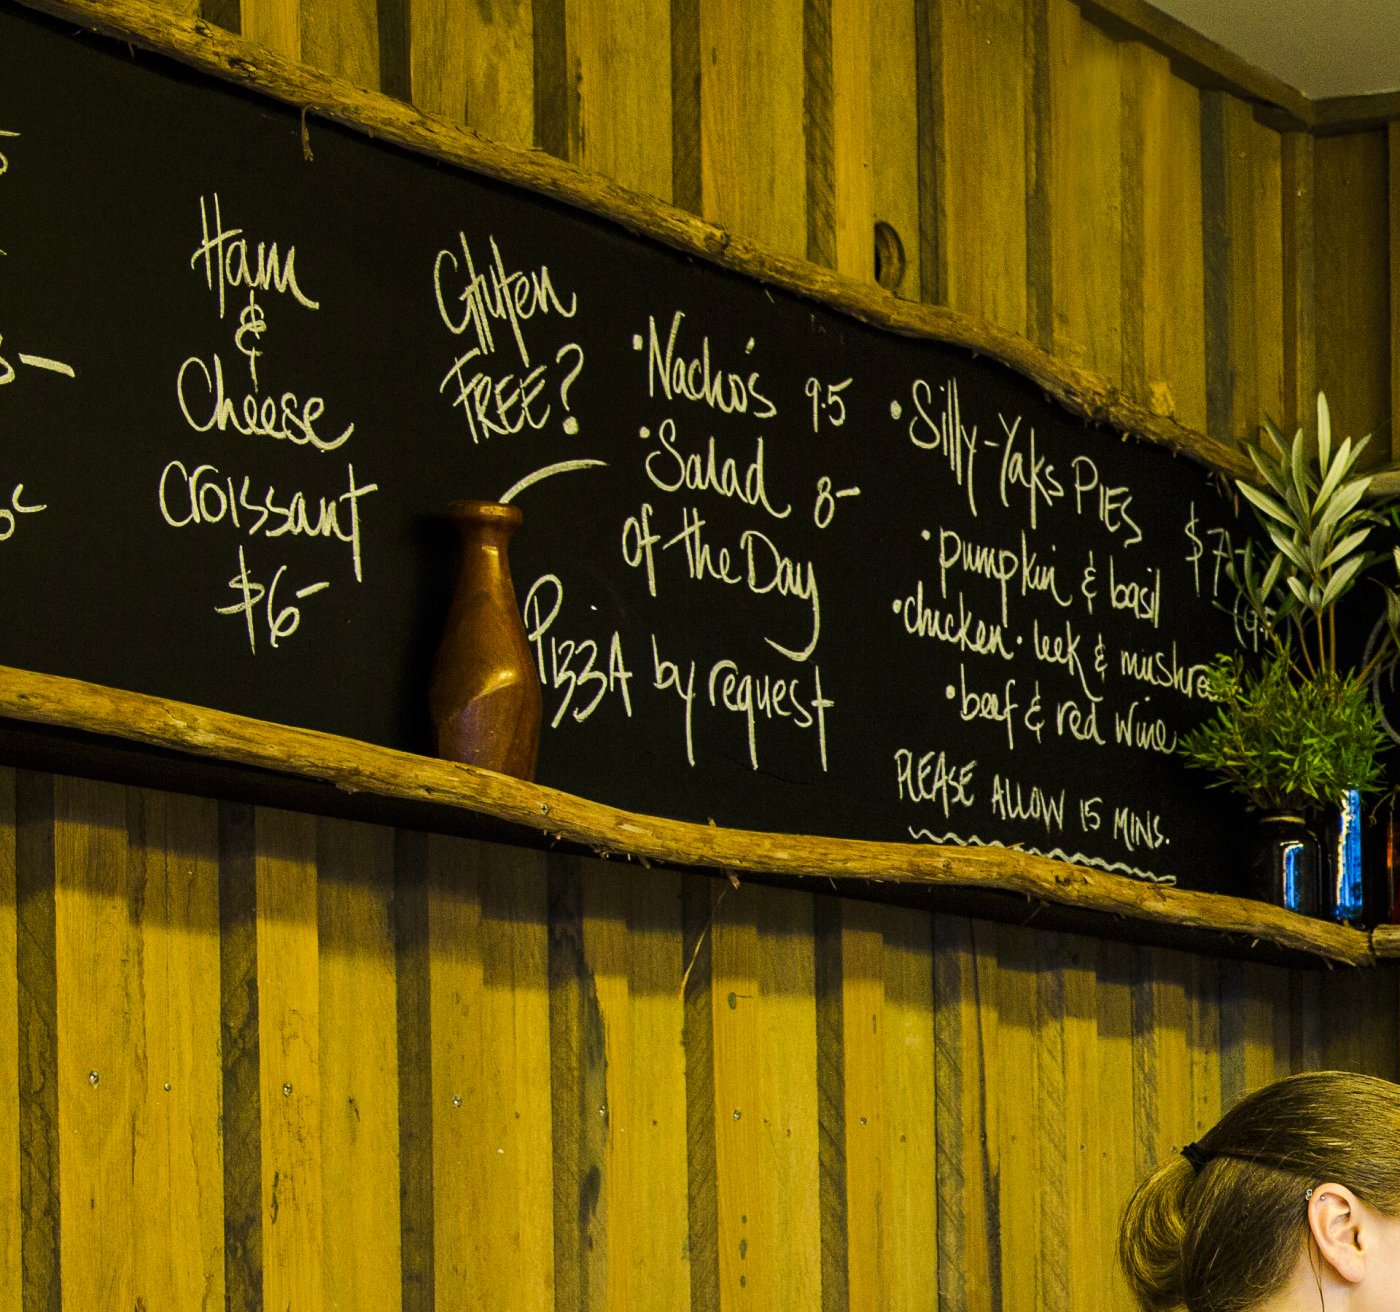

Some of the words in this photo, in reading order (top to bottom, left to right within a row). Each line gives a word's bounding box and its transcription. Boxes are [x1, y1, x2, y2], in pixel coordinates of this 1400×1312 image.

[191, 193, 319, 318] Ham
[434, 231, 577, 368] Gluten
[235, 290, 267, 391] &
[178, 353, 354, 451] Cheese
[159, 460, 378, 583] Croissant
[645, 418, 792, 519] Salad
[663, 507, 741, 584] the
[741, 530, 820, 662] Day
[939, 525, 1073, 628] pumpkin
[1081, 550, 1098, 614] &
[1109, 555, 1162, 628] basil
[903, 580, 1014, 660] chicken
[1033, 619, 1103, 702] leek
[1094, 632, 1108, 680] &
[652, 634, 696, 768] by
[708, 659, 835, 772] request
[960, 663, 1018, 750] beef
[1024, 680, 1043, 744] &
[1056, 701, 1106, 745] red
[894, 748, 978, 819] PLEASE
[991, 773, 1066, 833] ALLOW
[1079, 797, 1102, 832] 15
